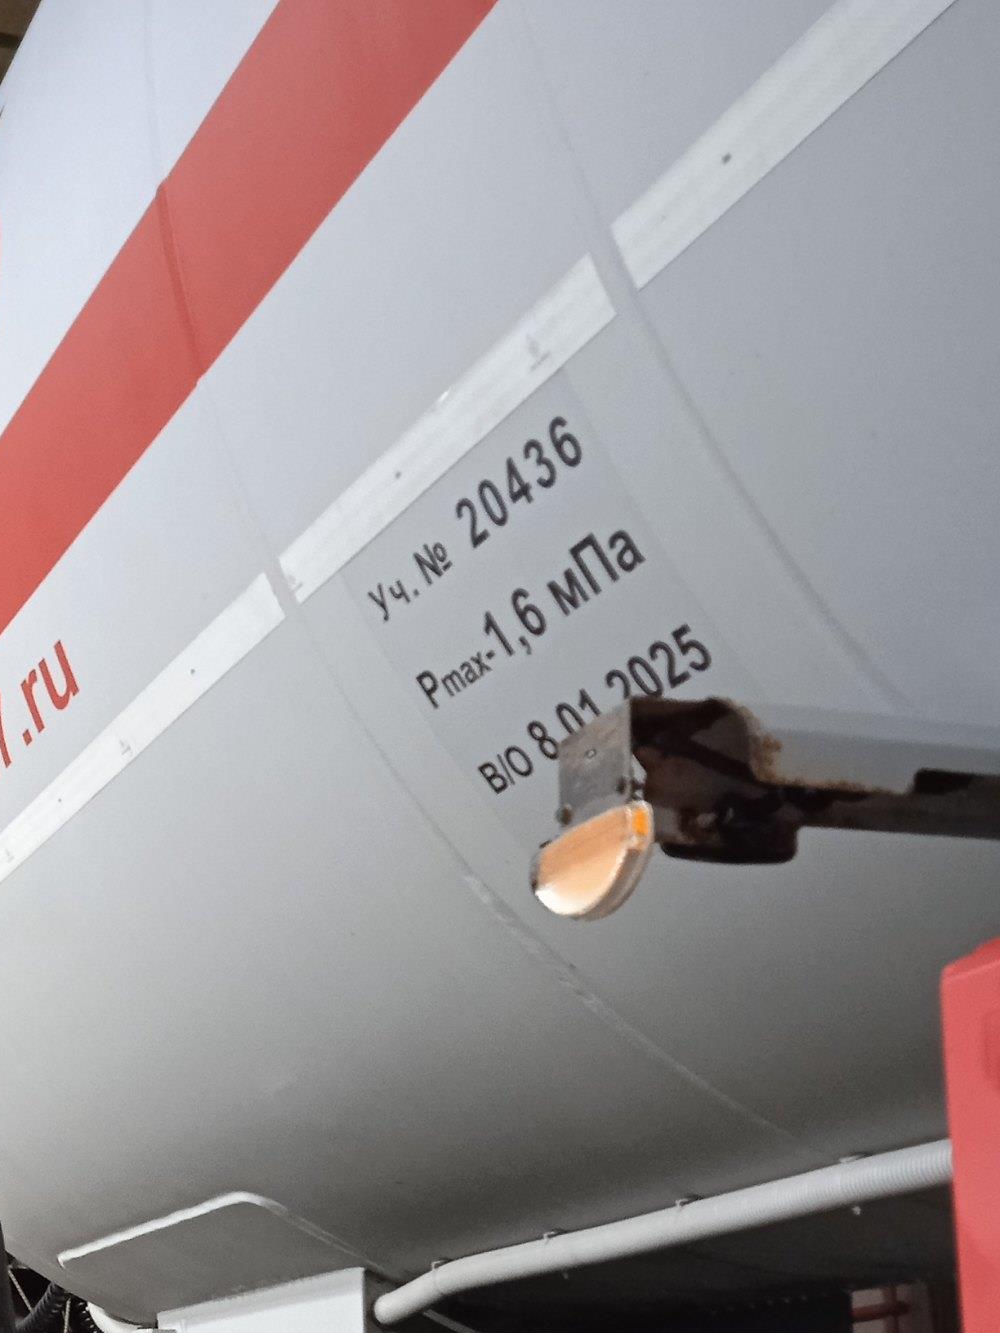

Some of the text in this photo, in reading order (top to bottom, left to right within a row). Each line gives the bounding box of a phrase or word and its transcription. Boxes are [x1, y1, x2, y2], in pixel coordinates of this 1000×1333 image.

[413, 542, 453, 585] №
[456, 416, 582, 548] 20436
[546, 530, 646, 616] мПа
